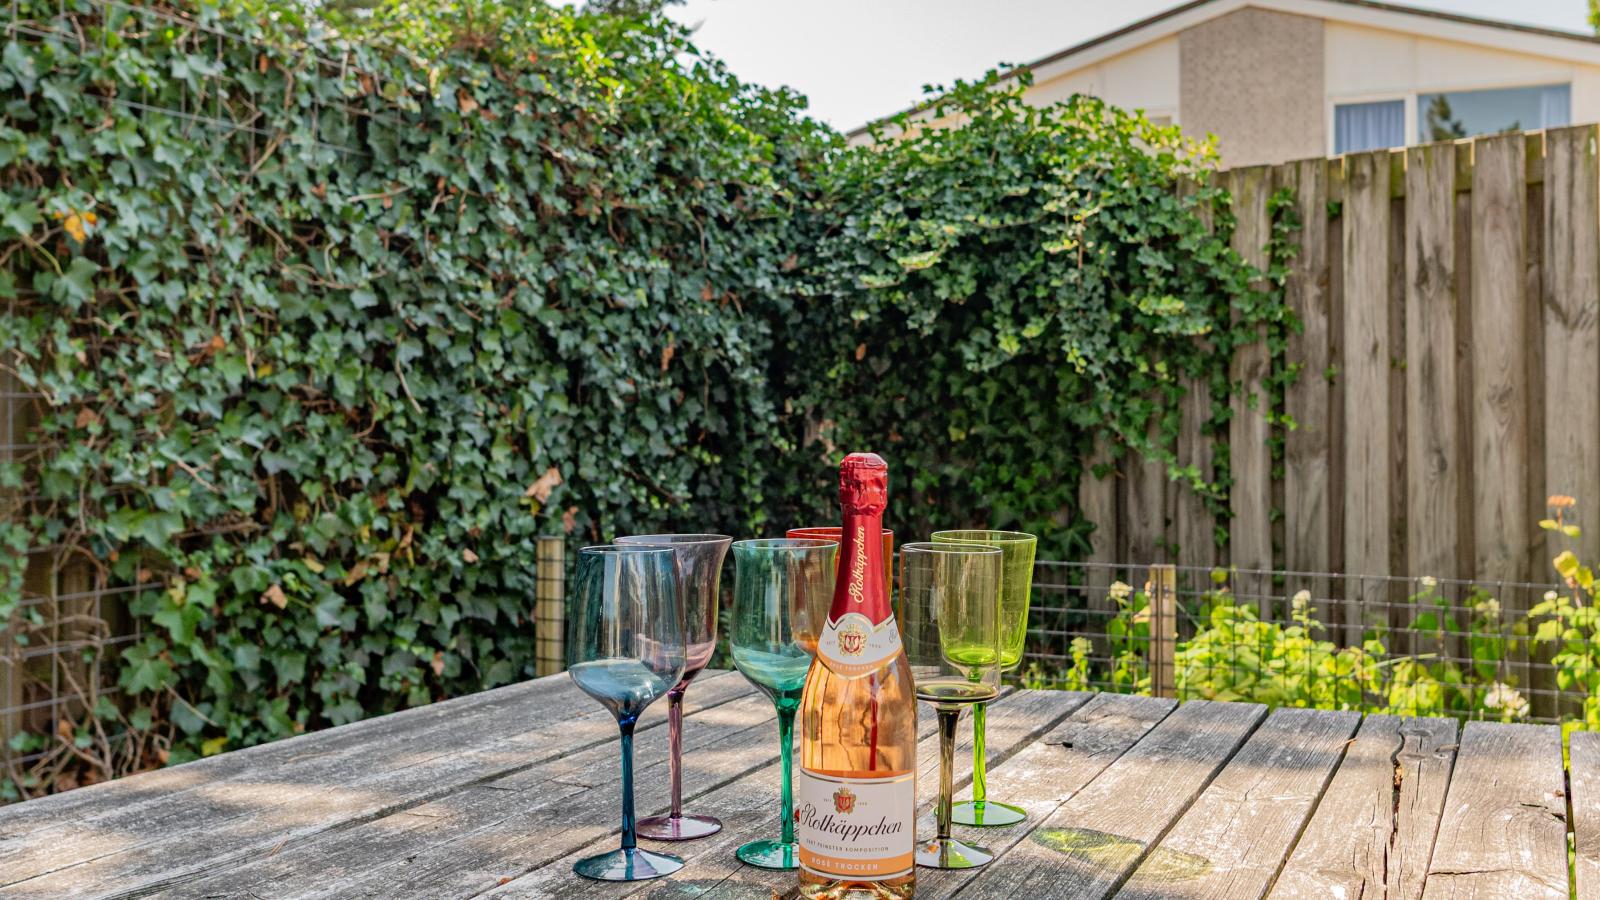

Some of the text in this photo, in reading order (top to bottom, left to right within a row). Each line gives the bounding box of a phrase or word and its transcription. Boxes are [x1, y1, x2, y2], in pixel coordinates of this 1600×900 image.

[848, 525, 867, 604] Rotkäppchen
[801, 803, 902, 841] Rotkäppchen
[835, 862, 879, 870] TROCKEN
